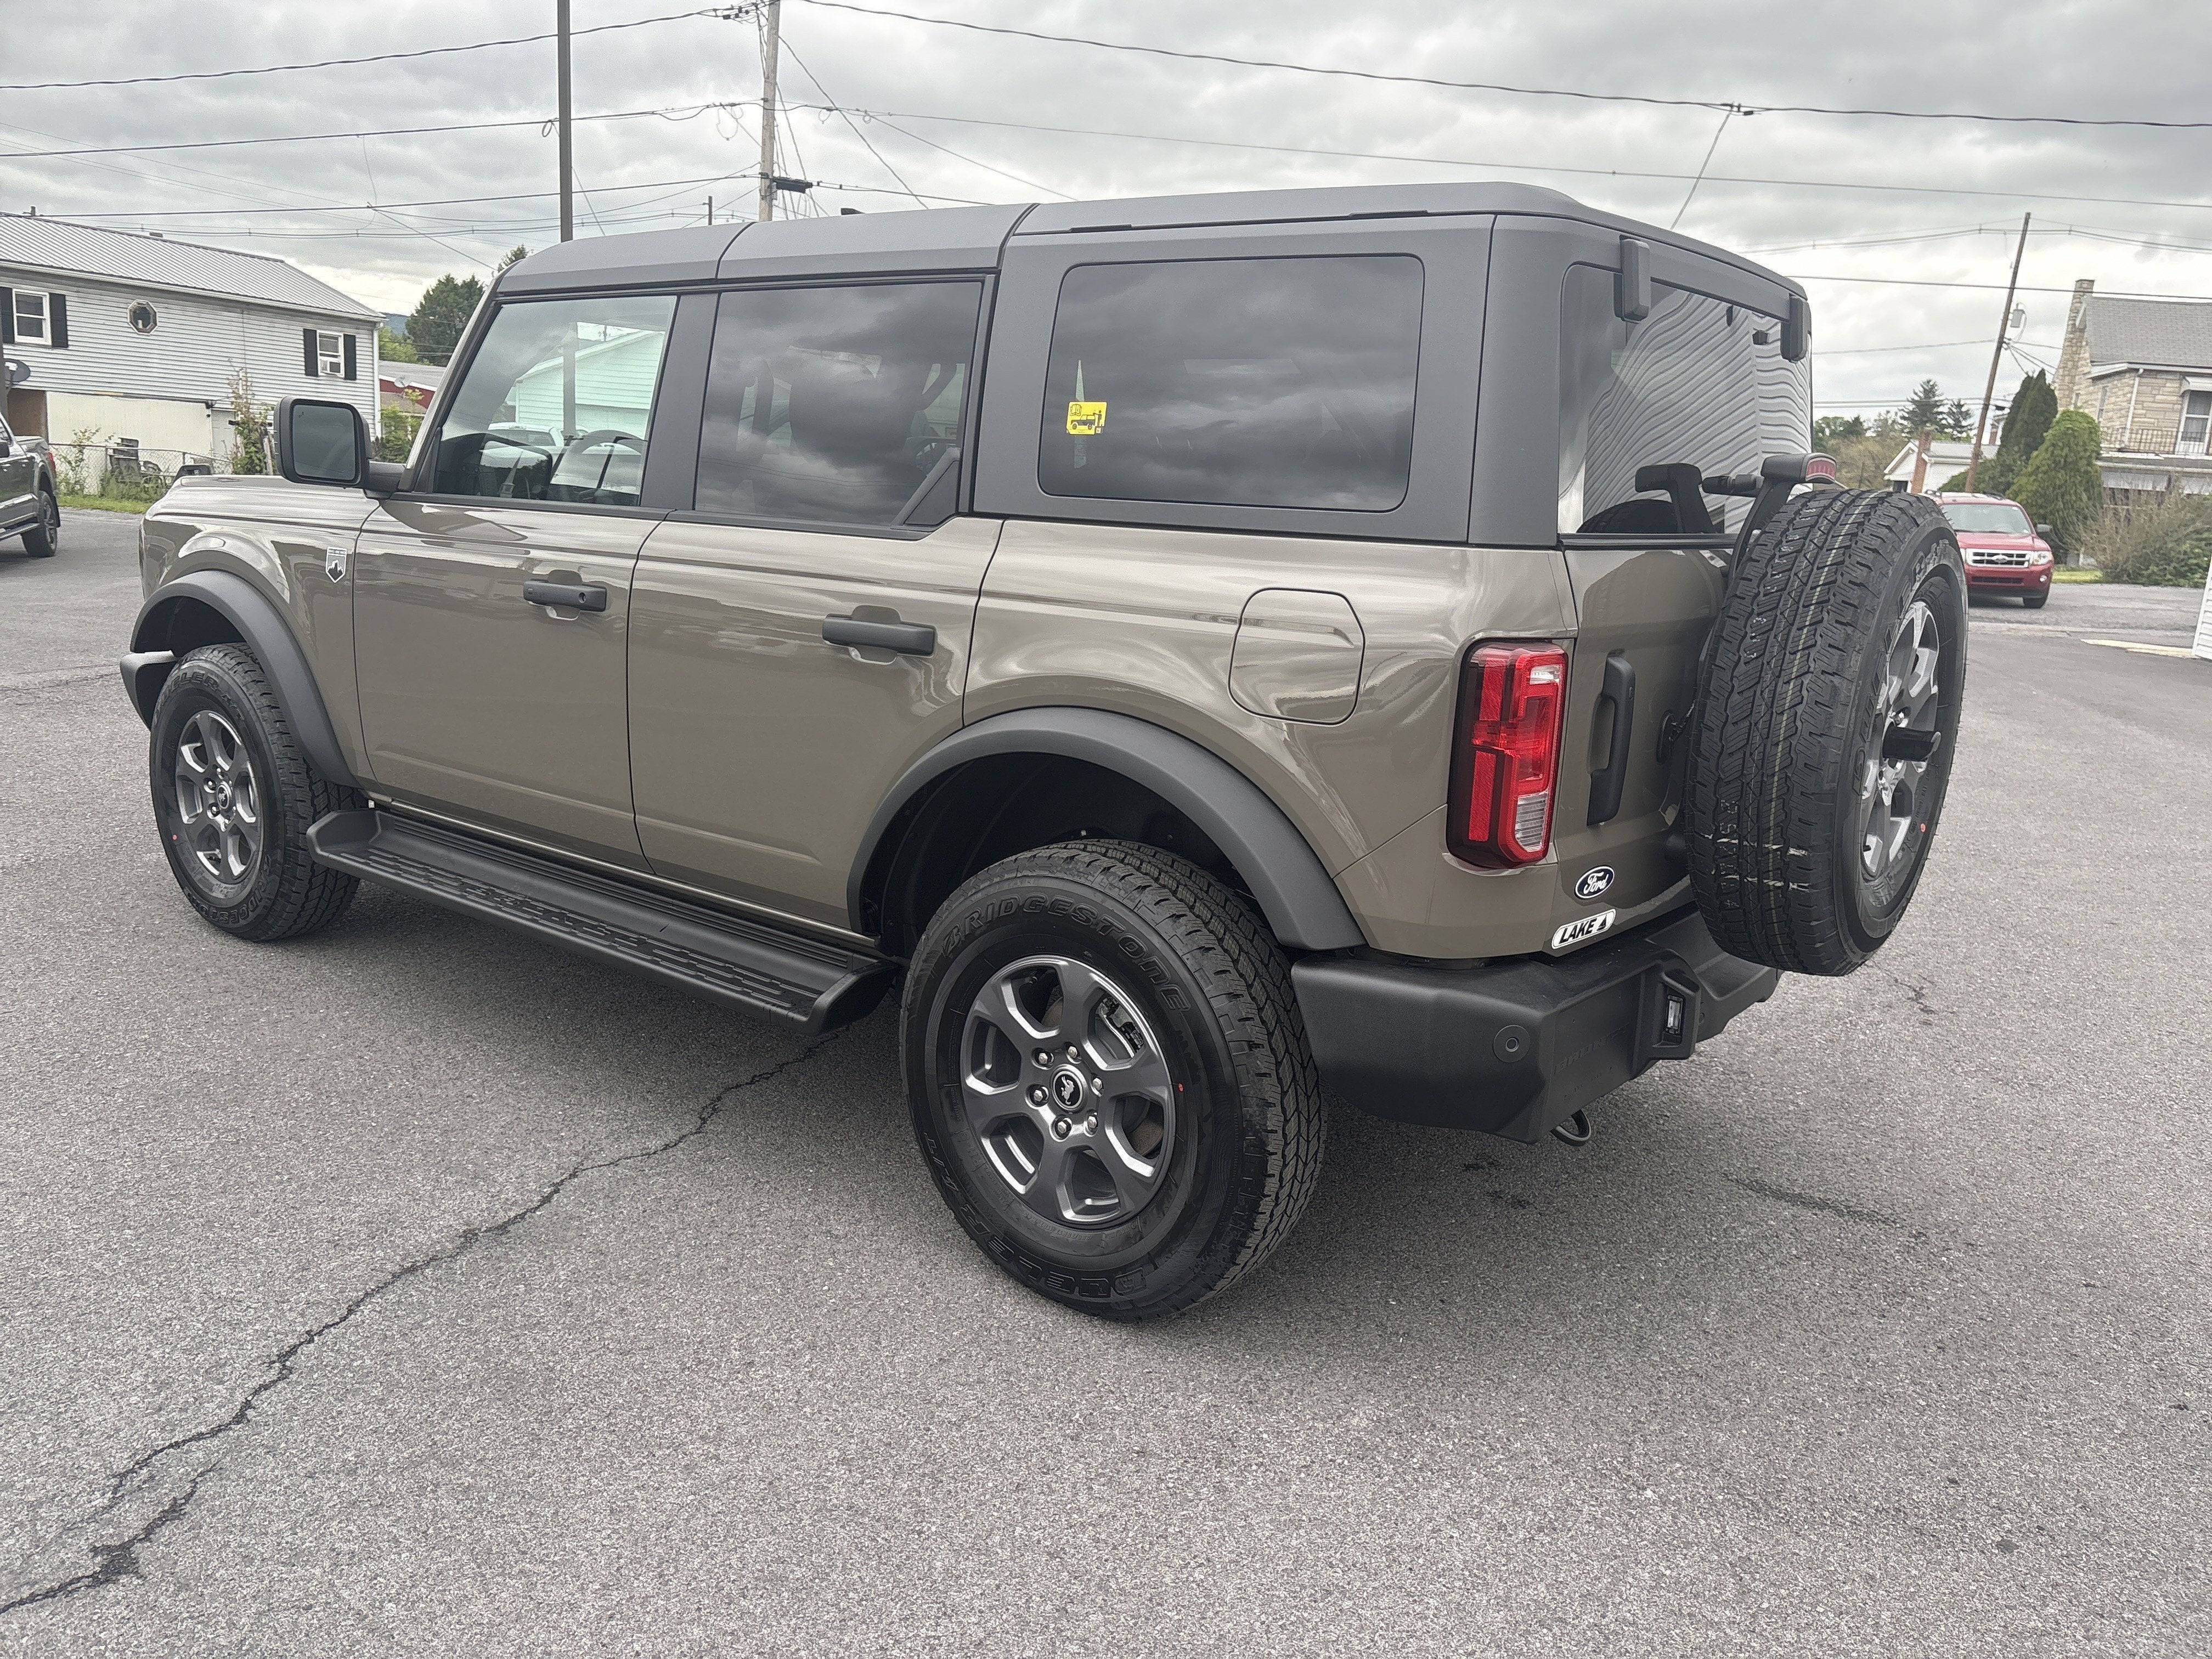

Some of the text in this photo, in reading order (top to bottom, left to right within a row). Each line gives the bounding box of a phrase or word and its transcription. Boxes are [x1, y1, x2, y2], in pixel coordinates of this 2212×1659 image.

[1583, 871, 1610, 894] Ford
[941, 891, 1193, 1012] BRIDGESTONE
[1559, 917, 1598, 944] LAKE
[960, 1204, 1147, 1299] DUELER
